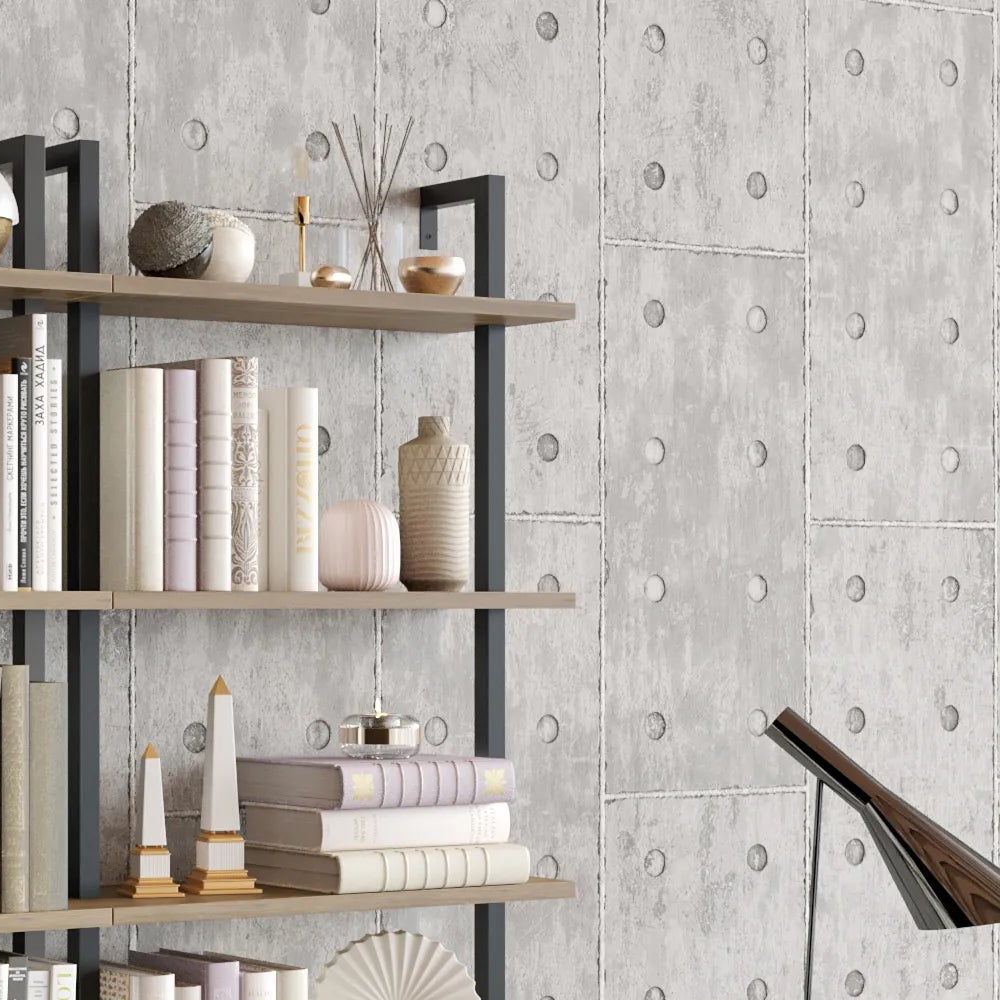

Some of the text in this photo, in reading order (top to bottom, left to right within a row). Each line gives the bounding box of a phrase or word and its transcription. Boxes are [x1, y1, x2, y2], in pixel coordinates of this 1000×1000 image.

[34, 345, 45, 426] ЗАХА ХАДИД
[50, 379, 58, 506] SELECTED STORIES
